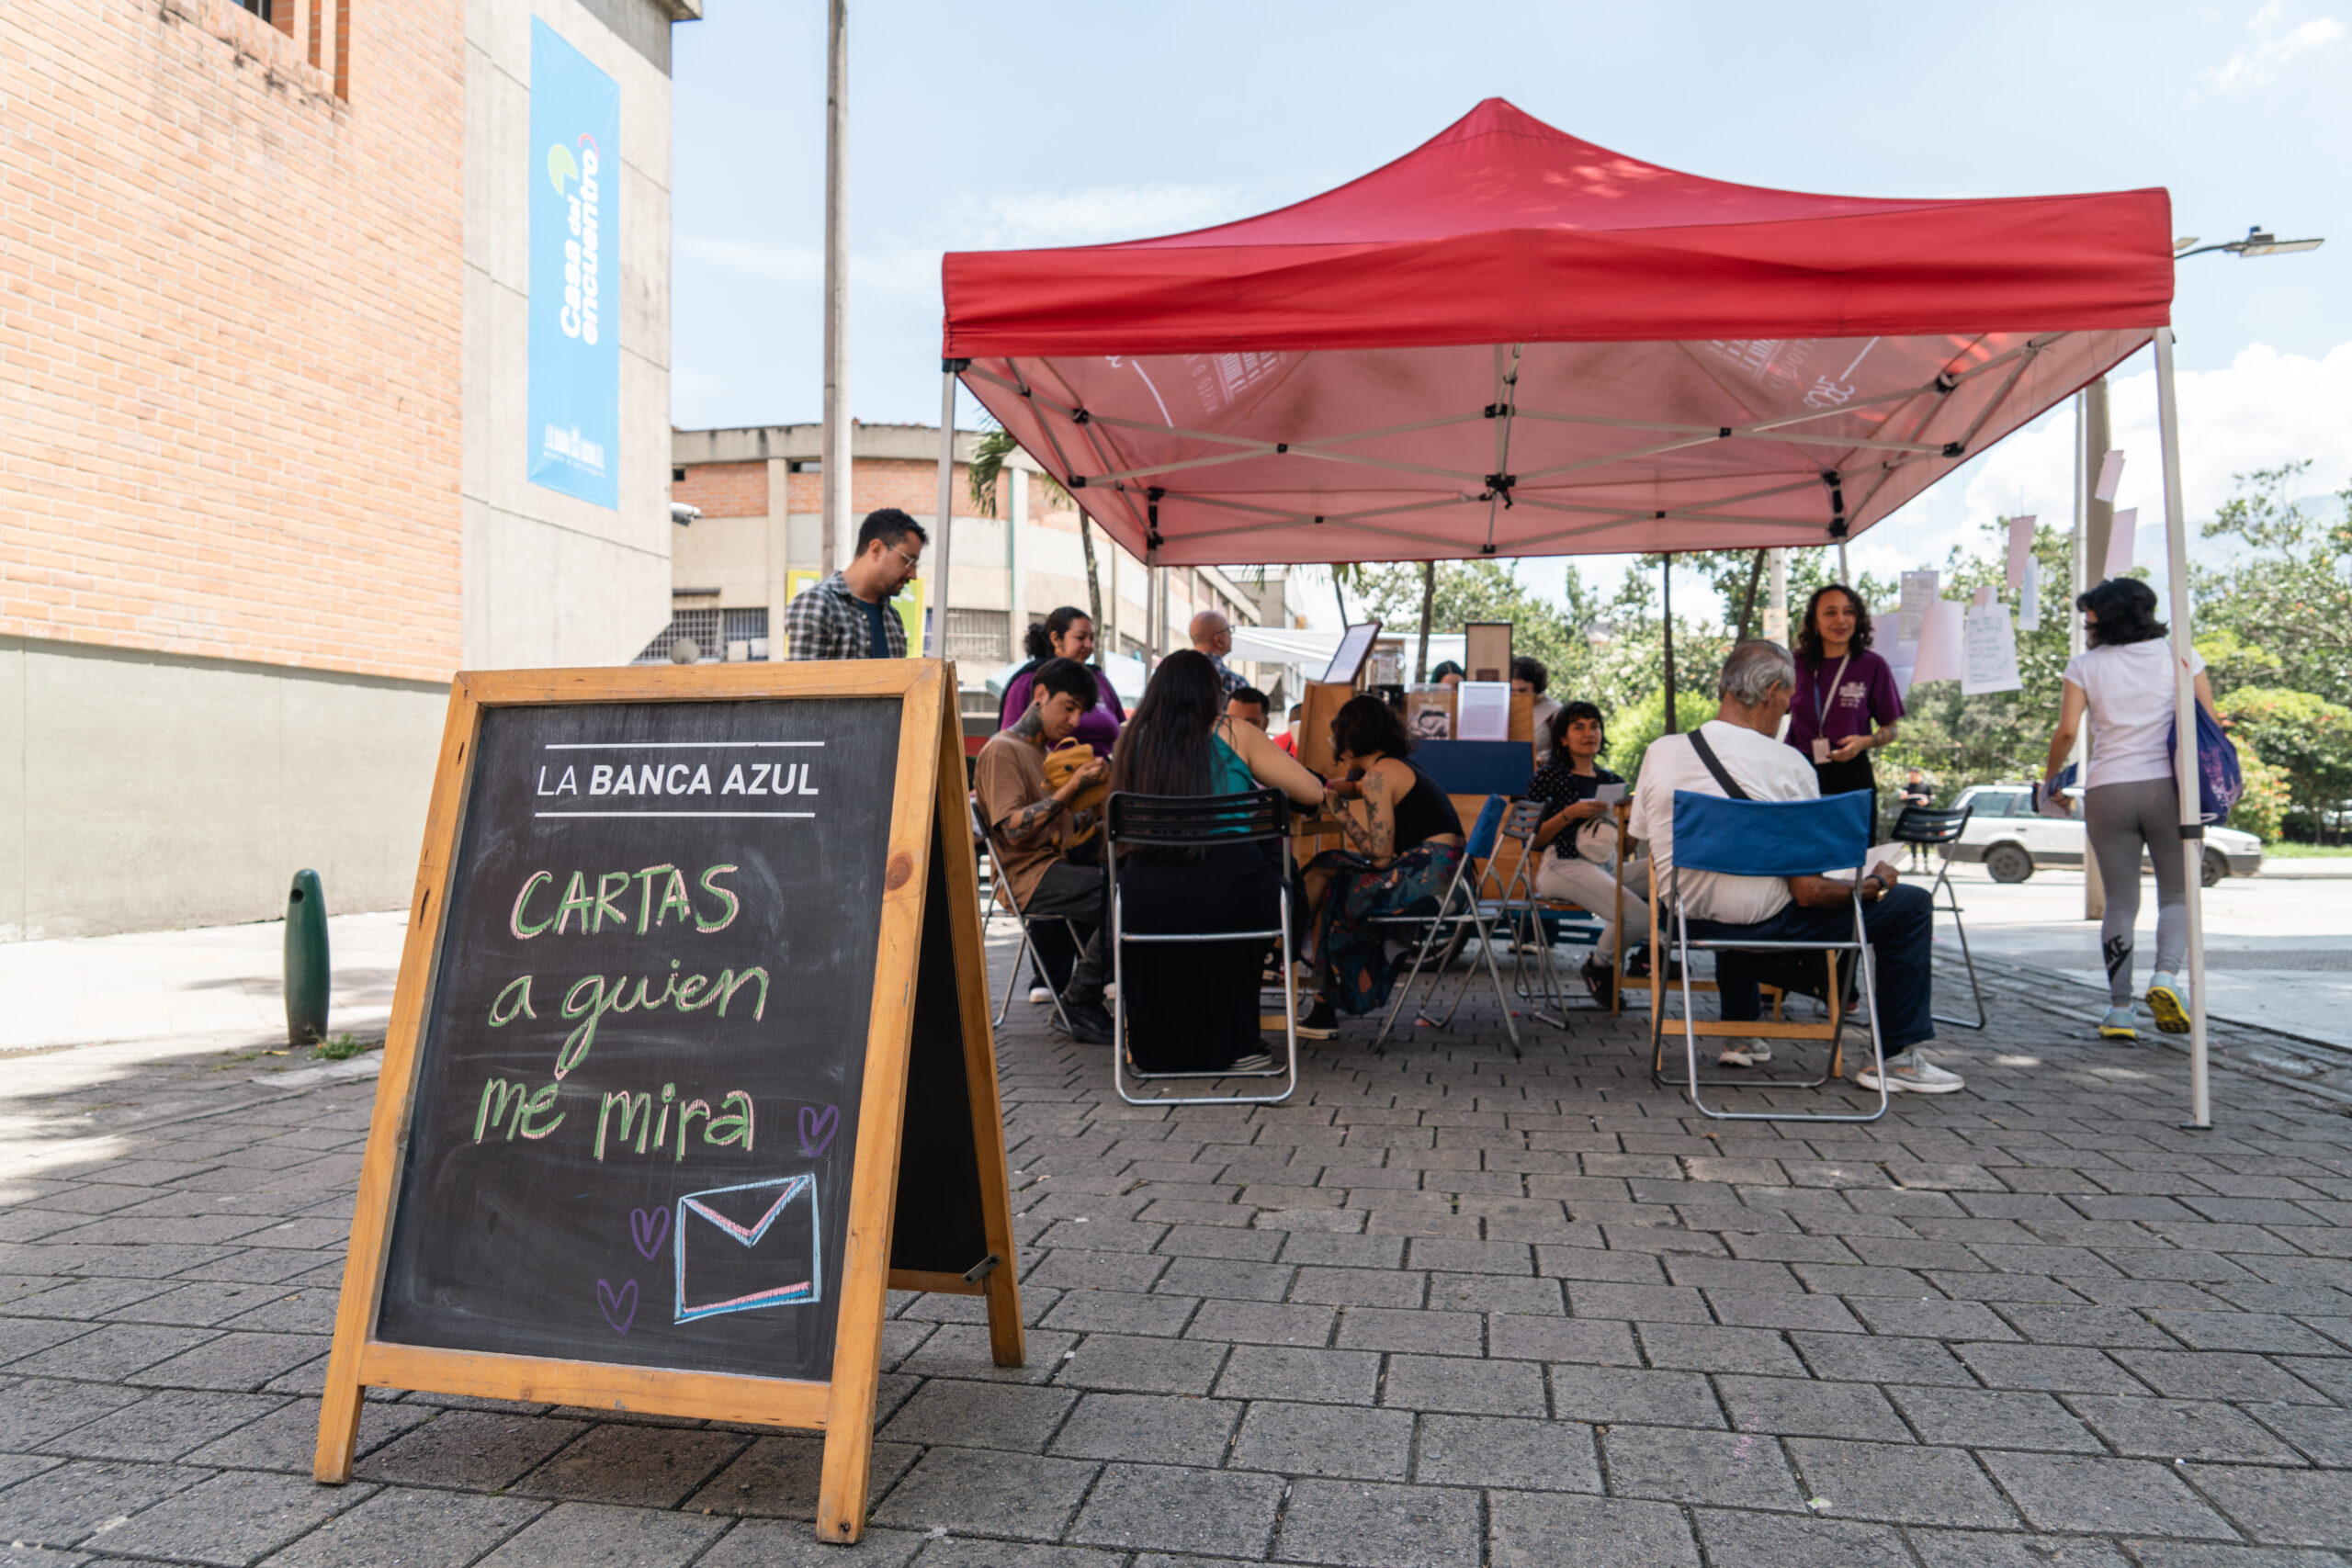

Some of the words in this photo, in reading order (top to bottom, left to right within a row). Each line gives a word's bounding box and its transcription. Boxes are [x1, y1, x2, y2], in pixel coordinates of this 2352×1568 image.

[567, 194, 582, 236] del
[580, 149, 599, 345] encuentro
[560, 239, 582, 339] Casa
[537, 764, 578, 796] LA
[589, 763, 712, 795] BANCA
[720, 763, 820, 795] AZUL
[510, 863, 740, 940] CARTAS
[488, 975, 537, 1028] a
[473, 1077, 567, 1145] me
[593, 1082, 754, 1162] mira
